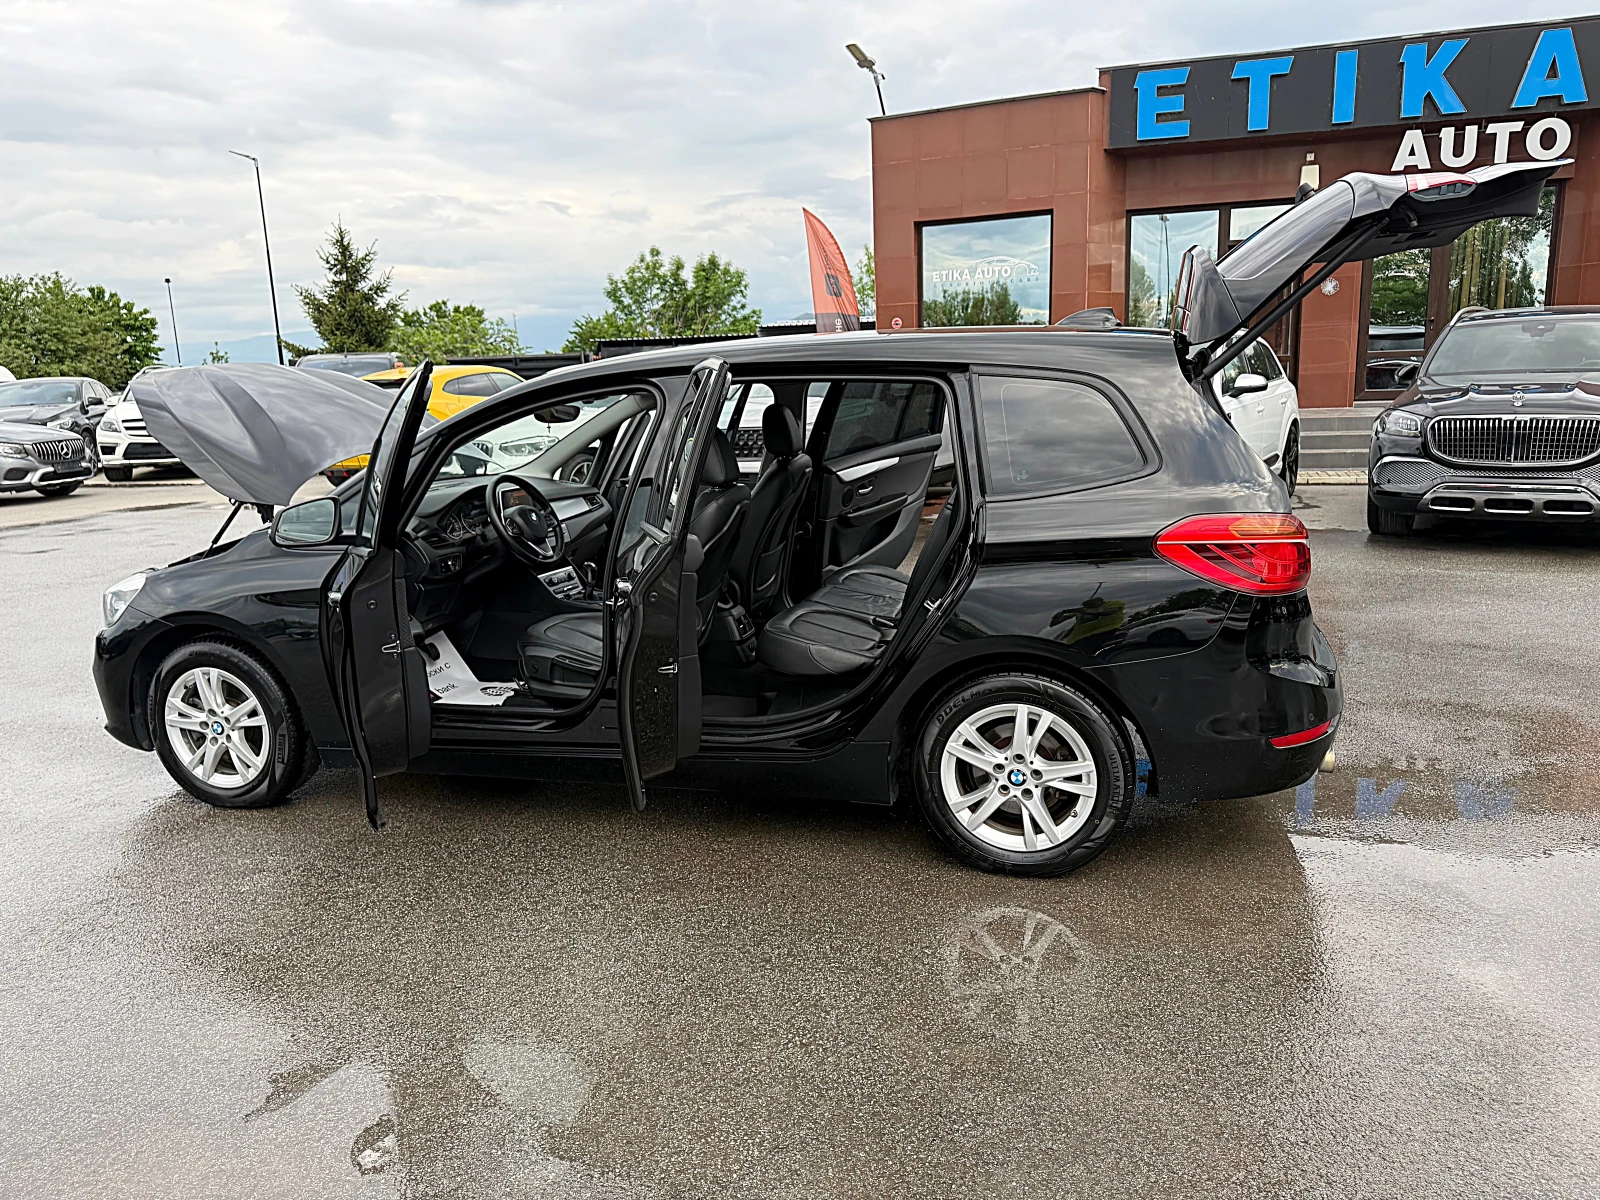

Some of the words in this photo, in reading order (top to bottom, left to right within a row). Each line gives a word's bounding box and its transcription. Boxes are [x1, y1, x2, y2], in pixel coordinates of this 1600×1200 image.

[1133, 27, 1589, 141] ETIKA
[1390, 117, 1572, 172] AUTO
[932, 269, 971, 282] ETIKA
[974, 266, 1012, 280] AUTO
